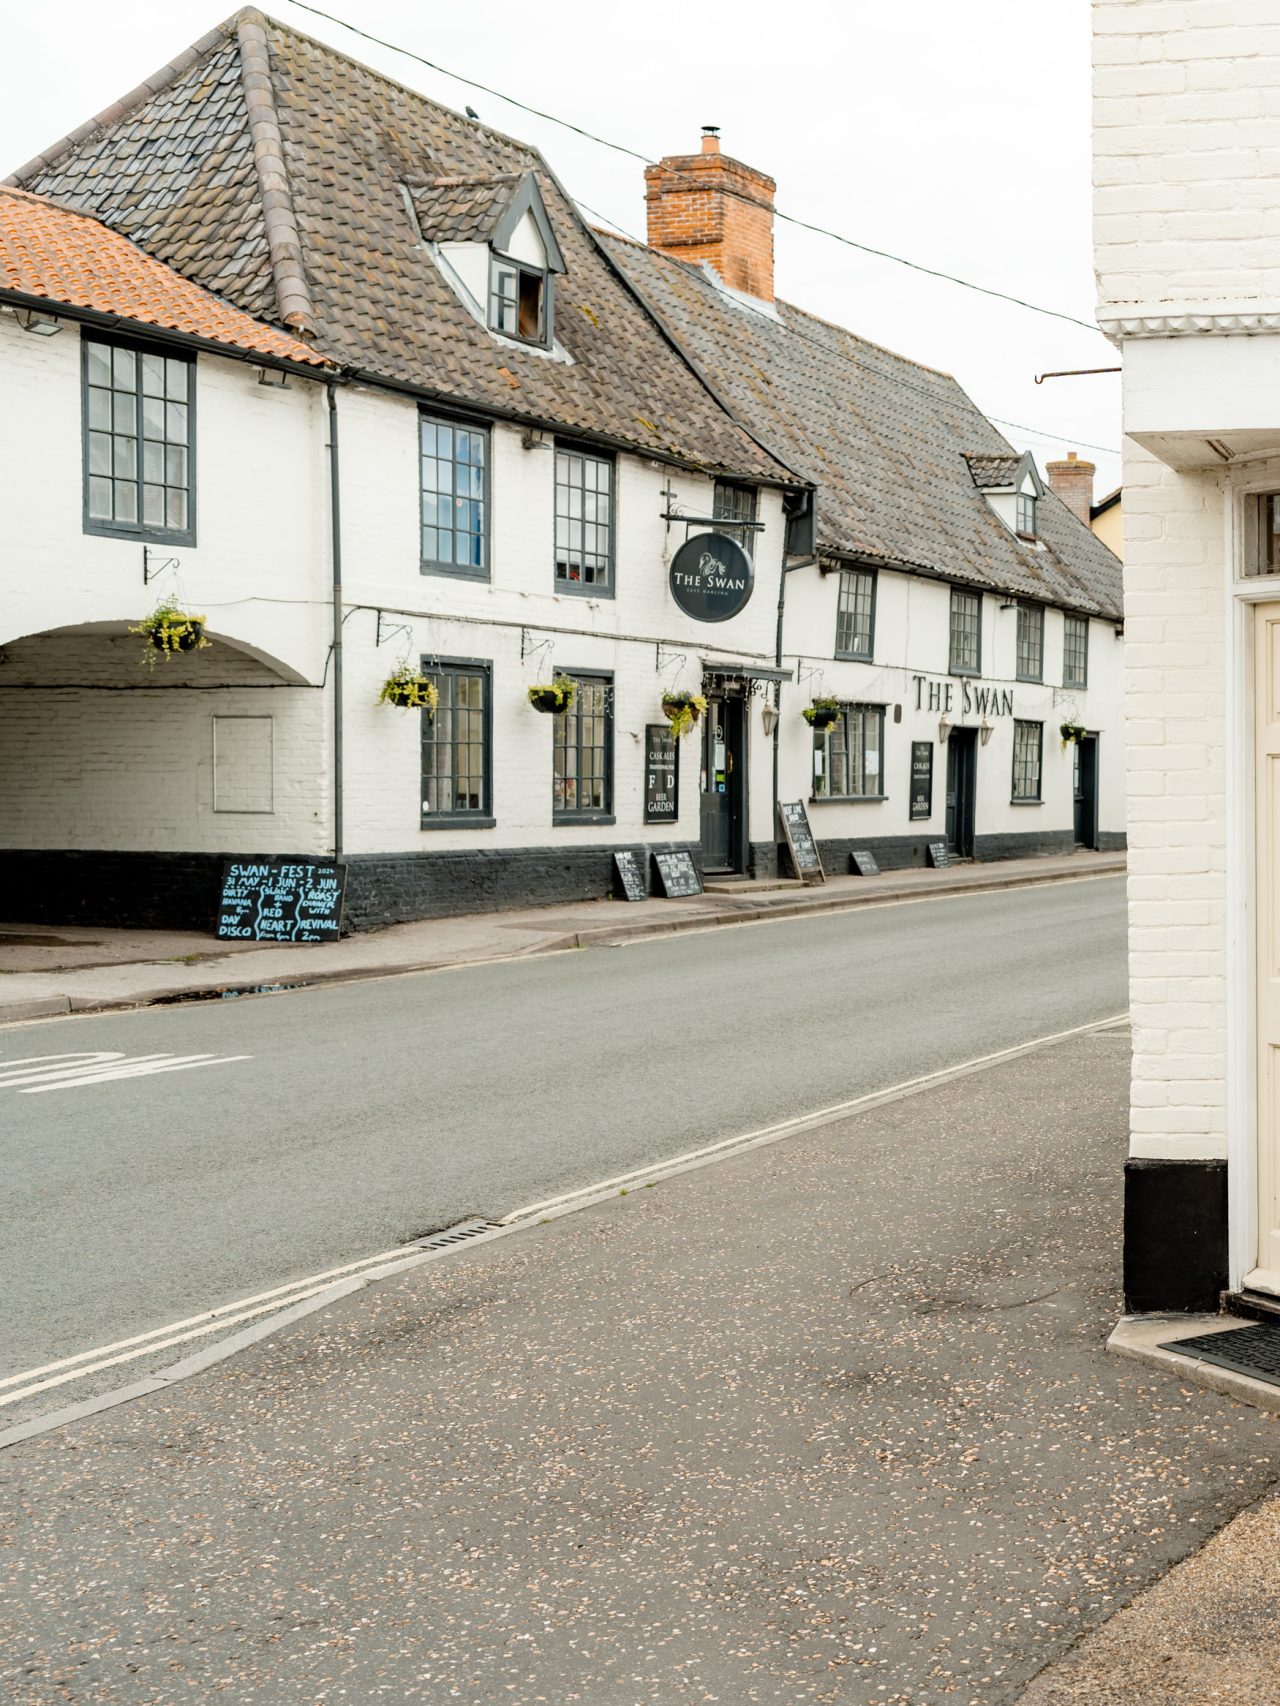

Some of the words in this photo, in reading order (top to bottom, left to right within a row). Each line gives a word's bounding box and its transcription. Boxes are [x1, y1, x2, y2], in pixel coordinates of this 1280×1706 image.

[674, 572, 702, 587] THE
[707, 575, 745, 590] SWAN
[912, 674, 953, 713] THE
[963, 680, 1014, 717] SWAN
[649, 751, 663, 761] CASK
[656, 793, 667, 802] BEER
[648, 801, 674, 812] GARDEN
[226, 877, 236, 885] 31
[238, 877, 260, 886] MAY
[276, 877, 296, 888] JUN
[317, 879, 337, 889] JUN
[222, 889, 249, 897] DIRTY
[264, 887, 287, 896] SWAN
[307, 891, 340, 902] ROAST
[222, 898, 252, 907] HAVANA
[302, 900, 335, 909] DINNER
[262, 908, 283, 918] RED
[221, 915, 241, 925] DAY
[300, 920, 339, 930] REVIVAL
[260, 920, 294, 932] HEART
[218, 926, 252, 937] DISCO
[301, 931, 320, 940] 2pm
